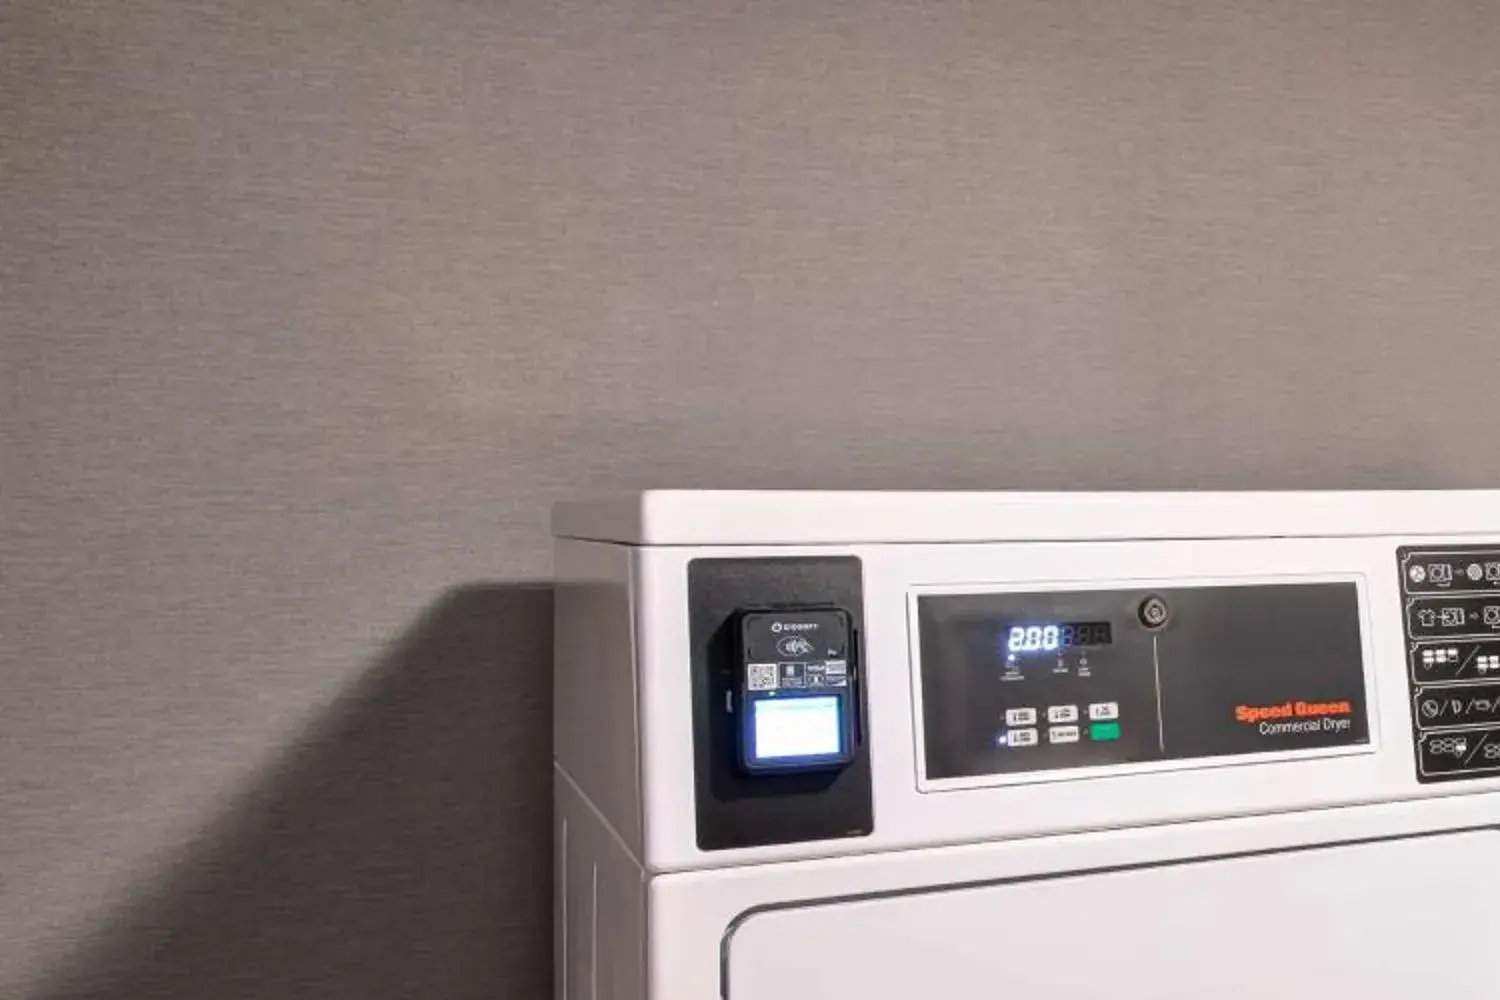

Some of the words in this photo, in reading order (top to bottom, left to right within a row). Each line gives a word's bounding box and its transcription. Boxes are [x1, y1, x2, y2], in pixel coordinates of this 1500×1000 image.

[1235, 703, 1292, 722] Speed
[1295, 701, 1351, 716] Queen
[1259, 719, 1321, 735] Commercial
[1323, 717, 1351, 733] Dryer
